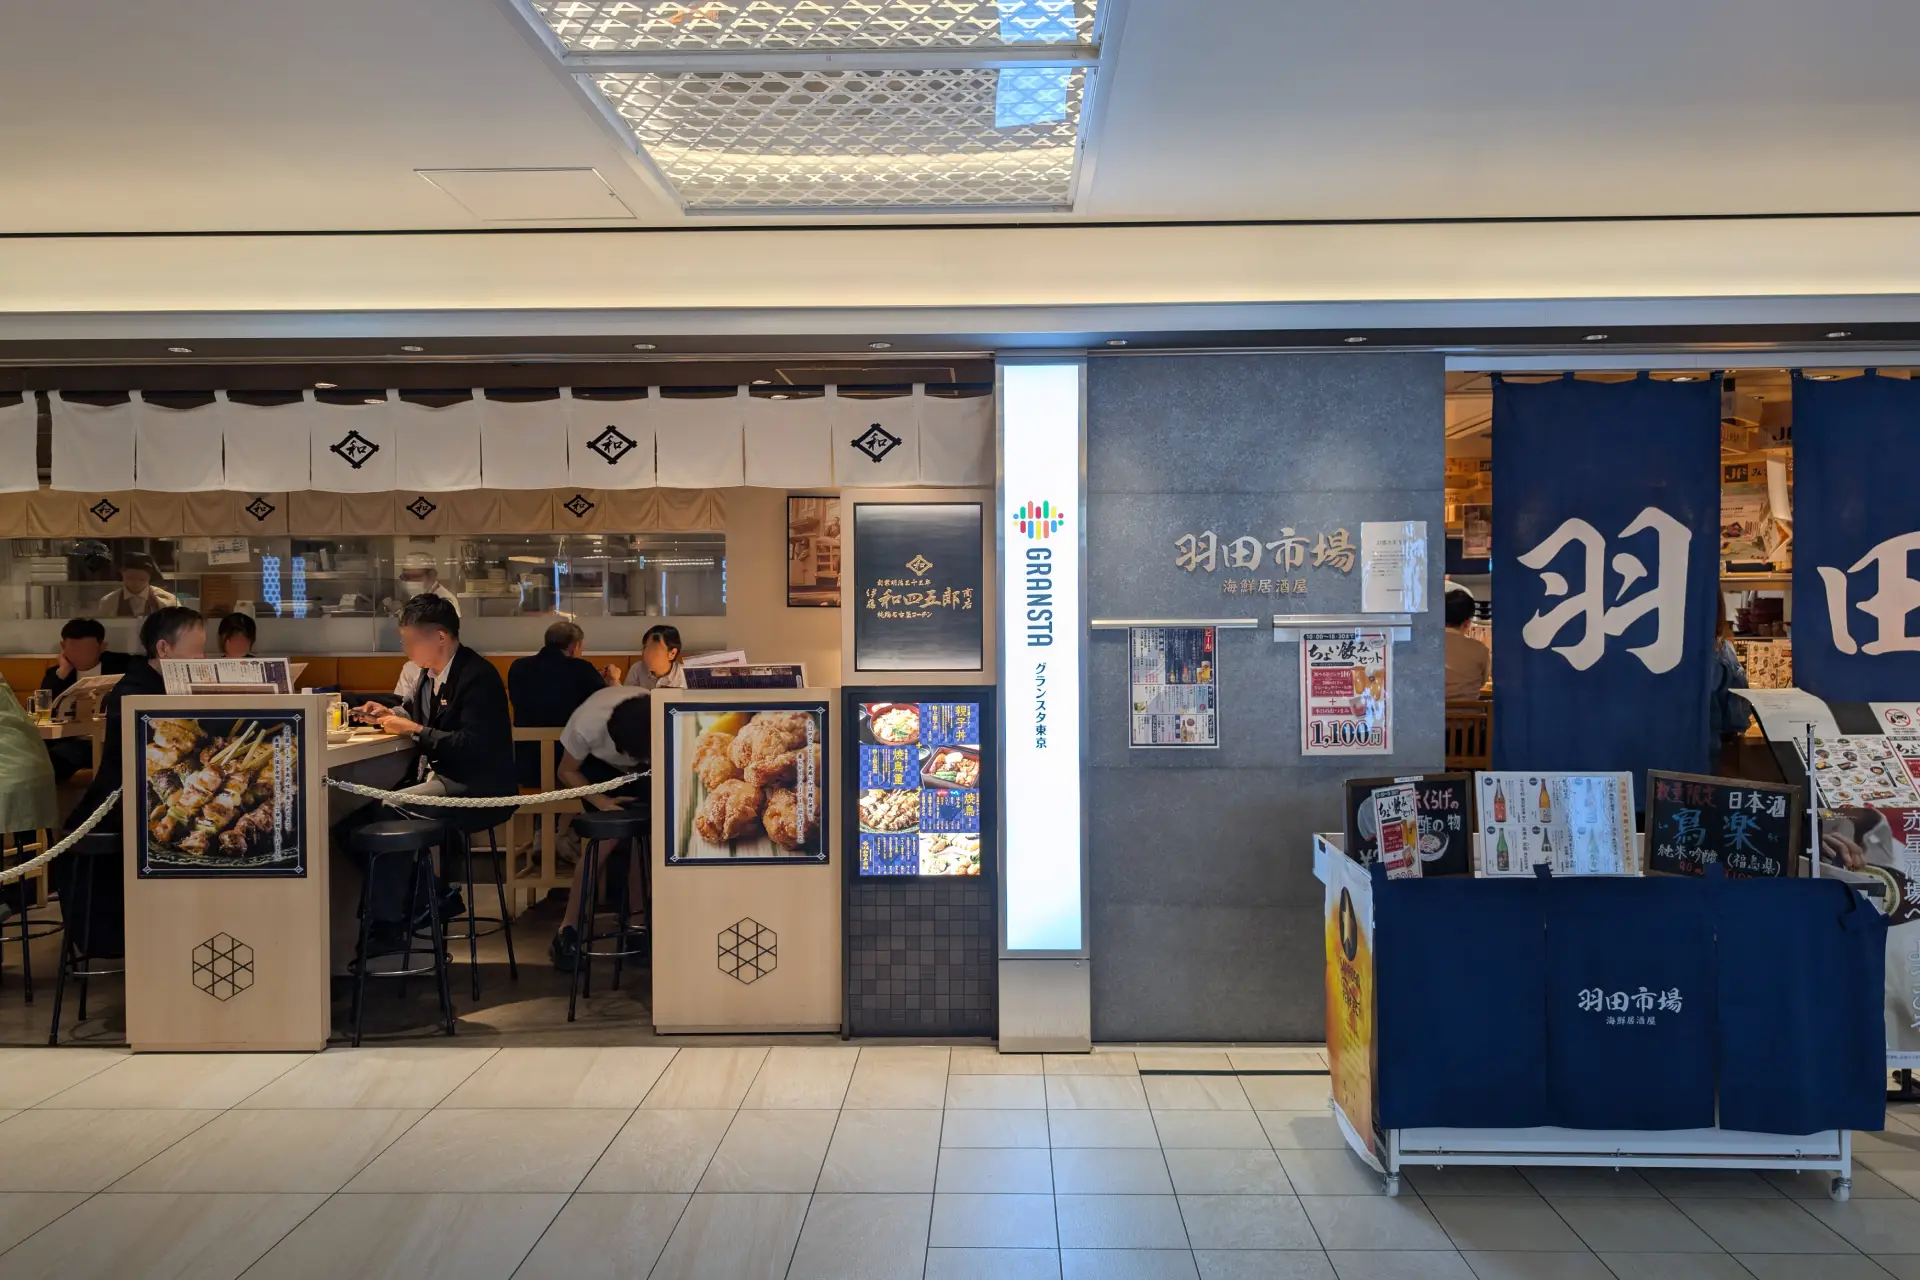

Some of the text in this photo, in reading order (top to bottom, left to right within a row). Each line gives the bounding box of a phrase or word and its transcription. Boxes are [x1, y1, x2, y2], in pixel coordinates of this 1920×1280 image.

[346, 440, 367, 458] 和
[601, 435, 623, 453] 和
[865, 433, 888, 451] 和
[1174, 527, 1357, 573] 羽田市場
[878, 587, 961, 610] 和四五郎
[1026, 547, 1053, 646] GRANSTA
[1223, 578, 1309, 594] 海鮮居酒屋
[1517, 506, 1692, 674] 羽
[1035, 662, 1047, 749] グランスタ東京
[955, 705, 967, 742] 親子丼
[892, 748, 905, 785] 焼鳥重
[964, 791, 976, 817] 焼鳥
[1729, 790, 1786, 818] 日本酒
[1578, 986, 1683, 1013] 羽田市場
[1606, 1016, 1657, 1026] 海鮮居酒屋
